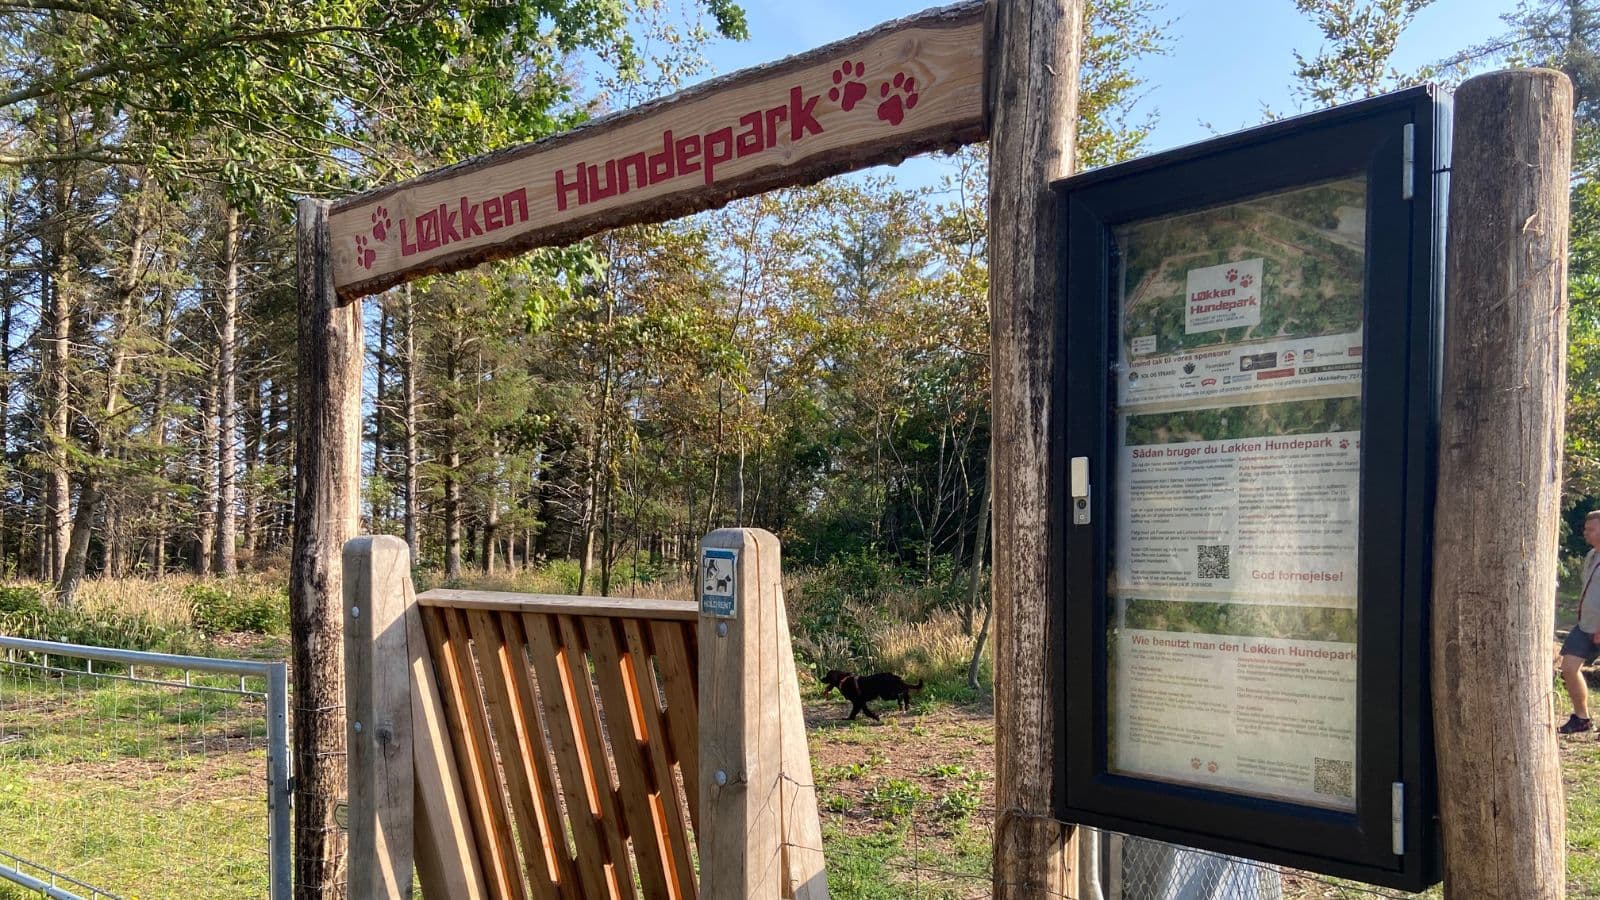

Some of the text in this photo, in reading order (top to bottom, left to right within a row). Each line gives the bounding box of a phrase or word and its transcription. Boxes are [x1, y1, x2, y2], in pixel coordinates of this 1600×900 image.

[400, 86, 824, 257] Løkken Hundepark
[1190, 295, 1257, 314] Hundepark
[1191, 288, 1236, 301] Løkken
[1132, 437, 1332, 458] Sådan bruger du Løkken Hundepark
[1252, 570, 1275, 580] God
[1131, 635, 1150, 646] Wie
[1152, 636, 1190, 649] benutzt
[1193, 641, 1216, 651] man
[1219, 641, 1239, 652] den
[1289, 646, 1357, 661] Hundepark
